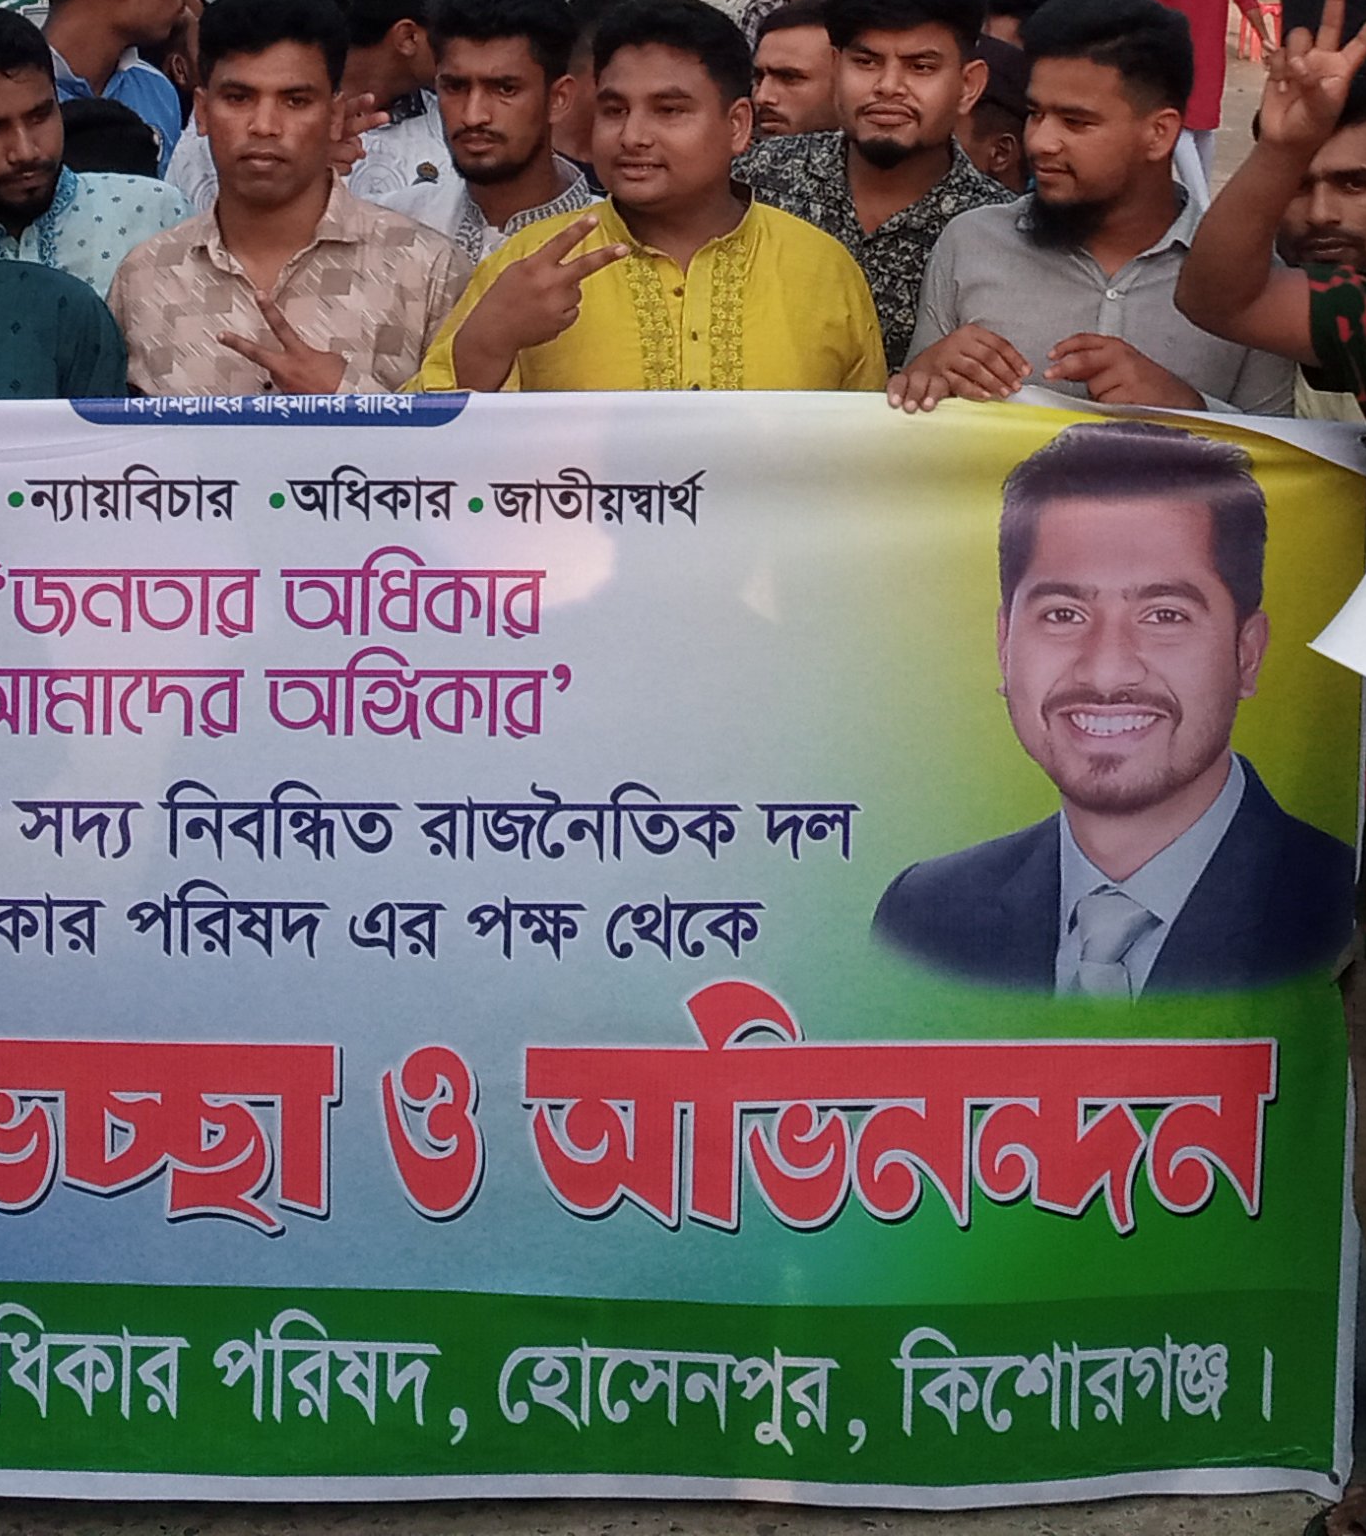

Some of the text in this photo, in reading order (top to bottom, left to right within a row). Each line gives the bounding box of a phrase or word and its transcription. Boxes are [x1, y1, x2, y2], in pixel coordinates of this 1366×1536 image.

[25, 463, 240, 522] ন্যায়বিচার
[286, 465, 458, 522] অধিকার
[488, 467, 707, 526] জাতীয়স্বার্থ
[280, 545, 547, 640] অধিকার
[12, 799, 144, 860] সদ্য
[158, 779, 403, 863] নিবন্ধিত
[414, 781, 742, 863] রাজনৈতিক
[756, 802, 861, 861] দল
[126, 878, 331, 960] পরিষদ
[349, 900, 448, 960] এর
[467, 894, 588, 962] পক্ষ
[606, 894, 767, 961] থেকে
[382, 1044, 485, 1221] ও
[524, 980, 1278, 1234] অভিনন্দন
[498, 1338, 868, 1456] হোসেনপুর,
